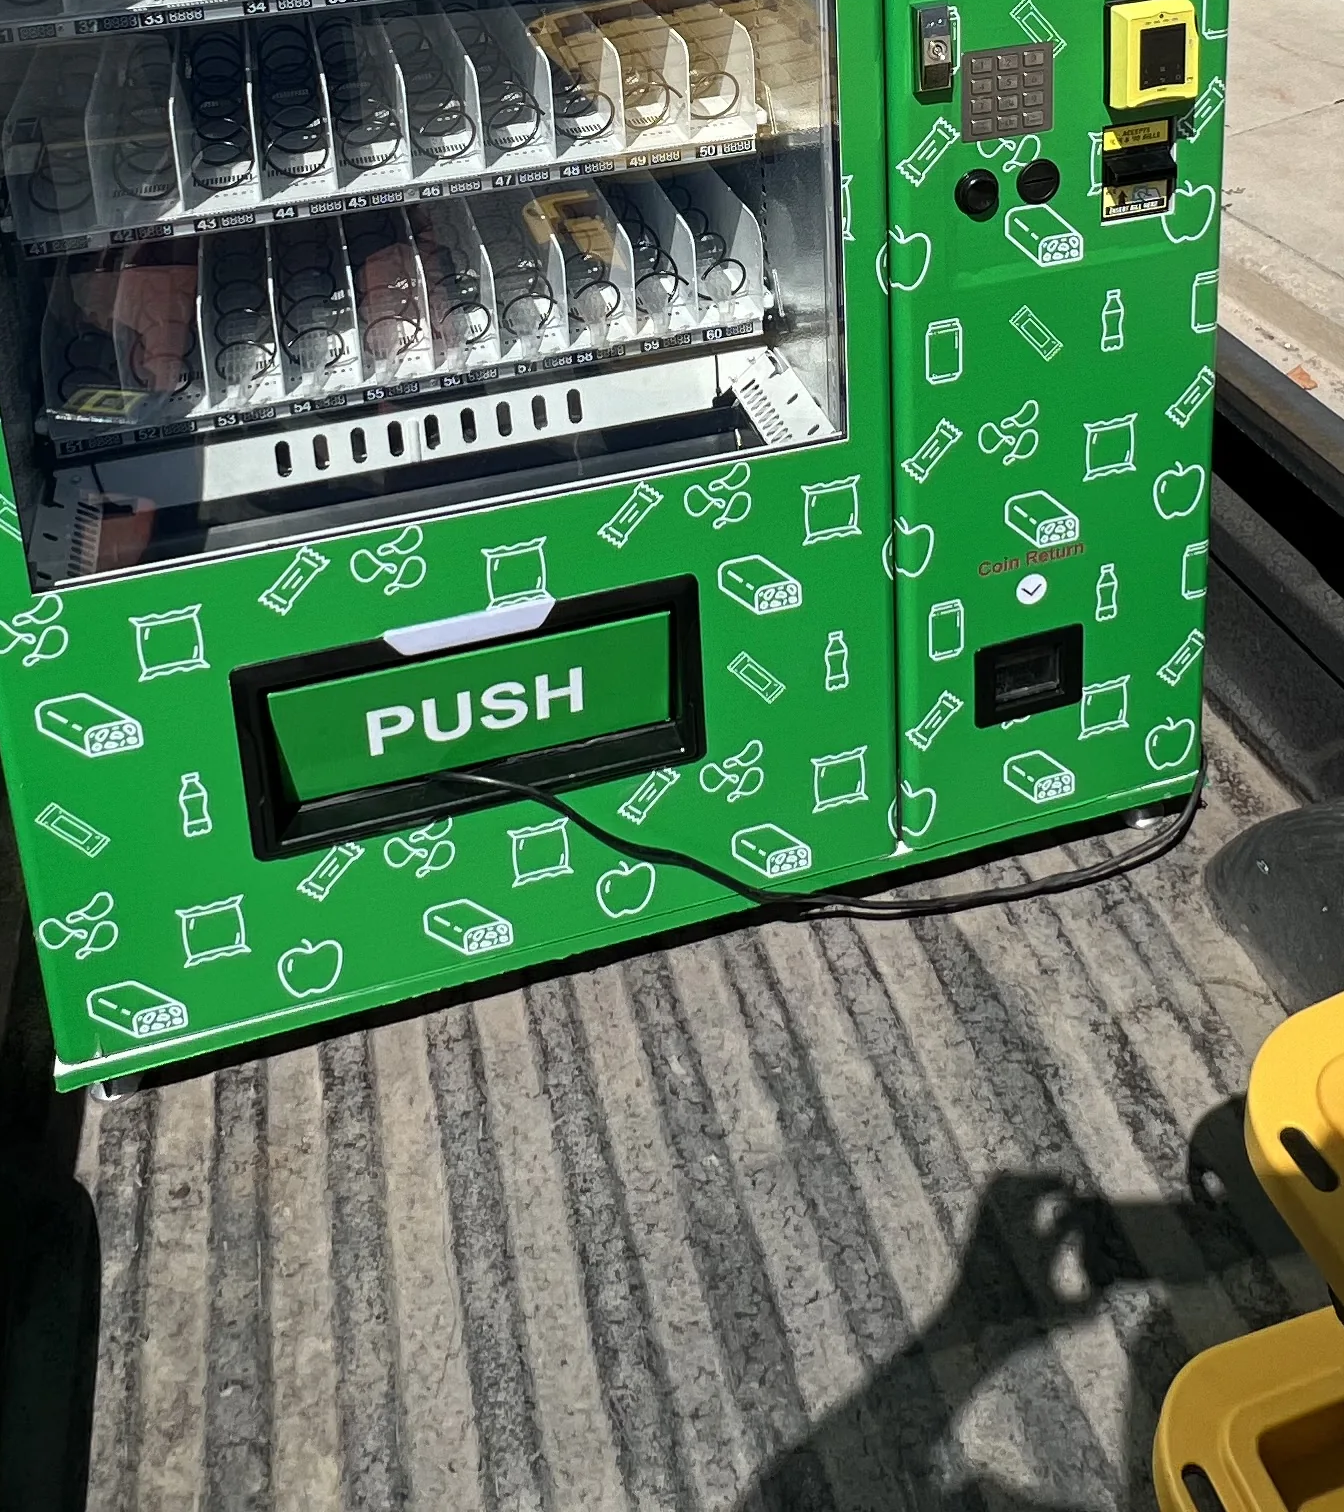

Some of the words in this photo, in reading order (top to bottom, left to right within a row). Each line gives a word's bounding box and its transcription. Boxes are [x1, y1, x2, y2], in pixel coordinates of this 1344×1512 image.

[144, 11, 164, 26] 33
[246, 1, 266, 14] 34
[29, 243, 48, 256] 41
[113, 229, 133, 242] 42
[197, 218, 217, 231] 43
[276, 206, 295, 219] 44
[348, 196, 367, 209] 45
[422, 185, 440, 197] 46
[494, 174, 513, 187] 47
[563, 164, 581, 177] 48
[629, 154, 647, 167] 49
[137, 427, 157, 440] 52
[218, 414, 237, 426] 53
[293, 400, 312, 413] 54
[366, 387, 385, 399] 55
[643, 339, 661, 351] 59
[706, 328, 723, 340] 60
[978, 556, 1020, 577] Coin
[1026, 542, 1085, 566] Return
[366, 666, 584, 757] PUSH
